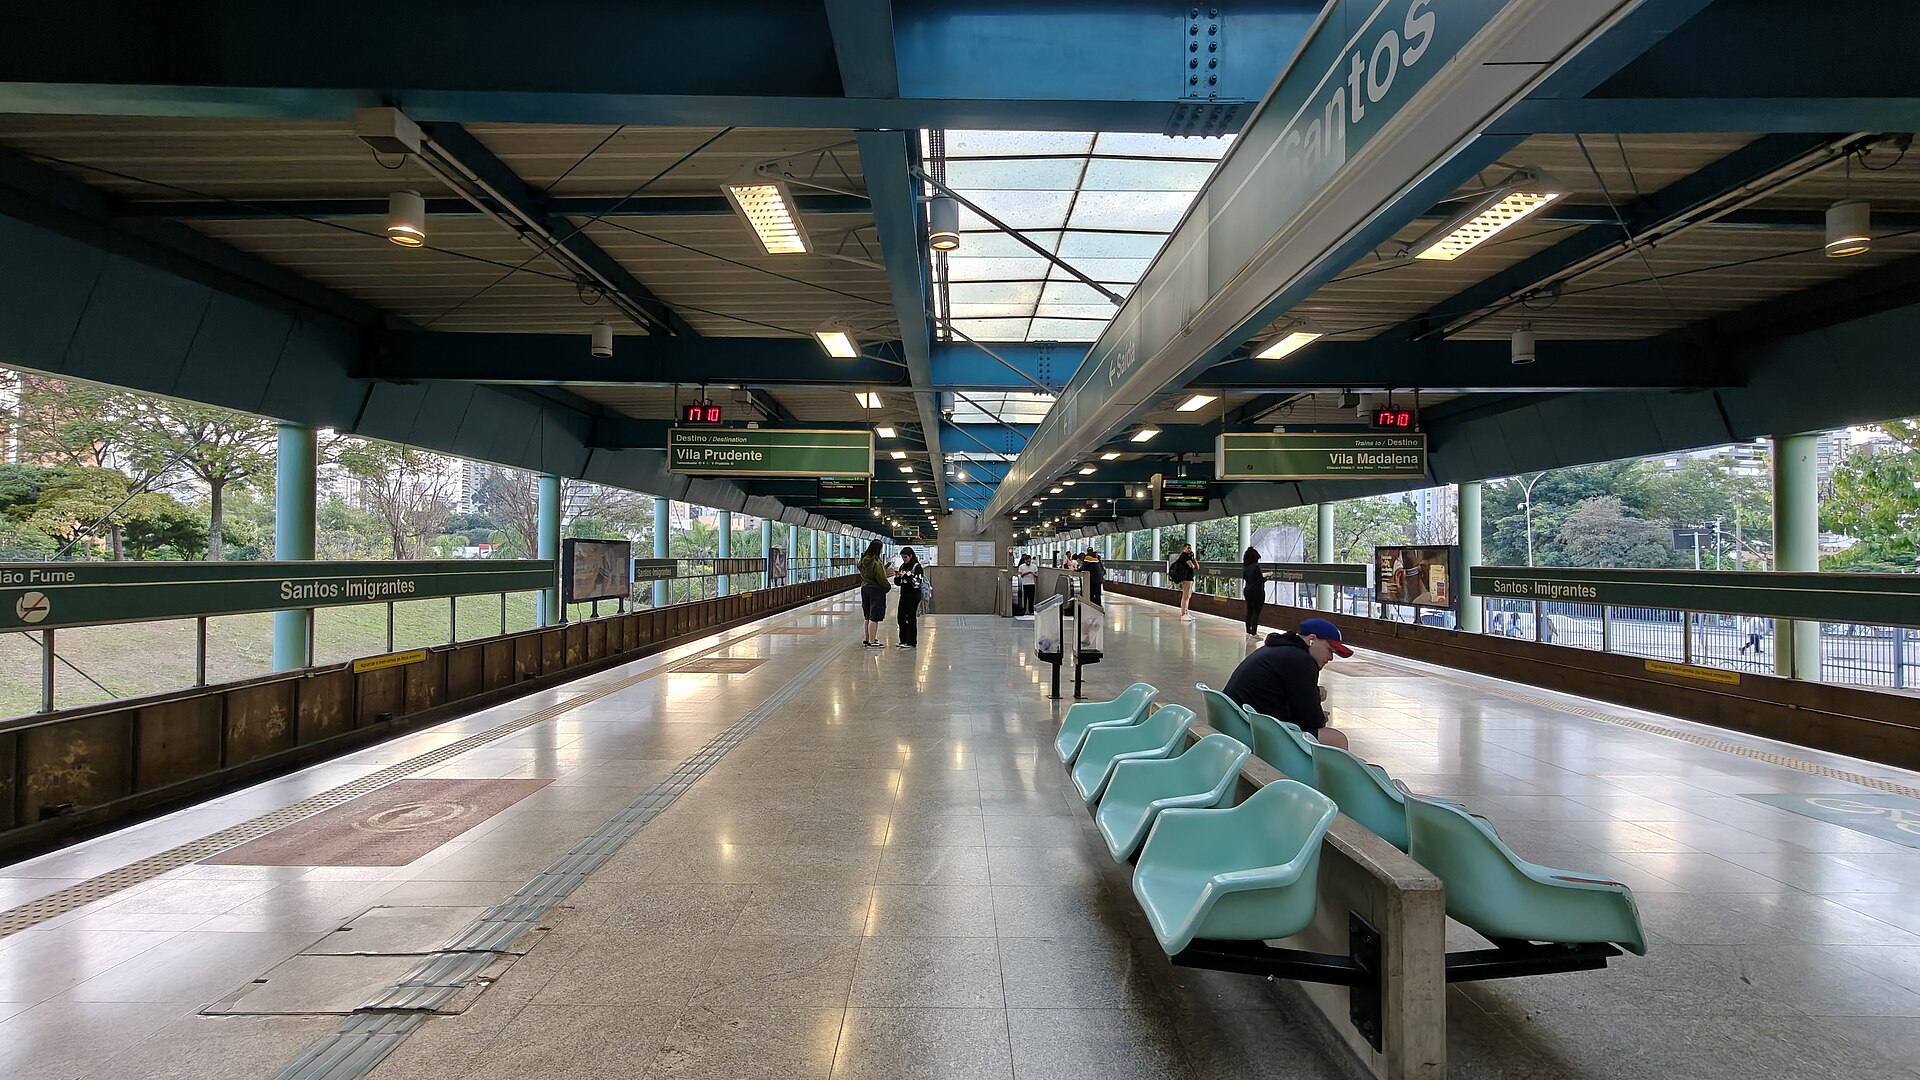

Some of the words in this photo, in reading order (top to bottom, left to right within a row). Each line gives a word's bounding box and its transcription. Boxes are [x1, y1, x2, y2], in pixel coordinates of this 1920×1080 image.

[1379, 412, 1409, 427] 17:10
[676, 434, 707, 442] Destino
[1387, 438, 1418, 446] Destino
[676, 448, 701, 460] Vila
[704, 449, 763, 461] Prudente
[1329, 453, 1353, 465] Vila
[1357, 452, 1418, 464] Madalena
[30, 570, 76, 582] Fume
